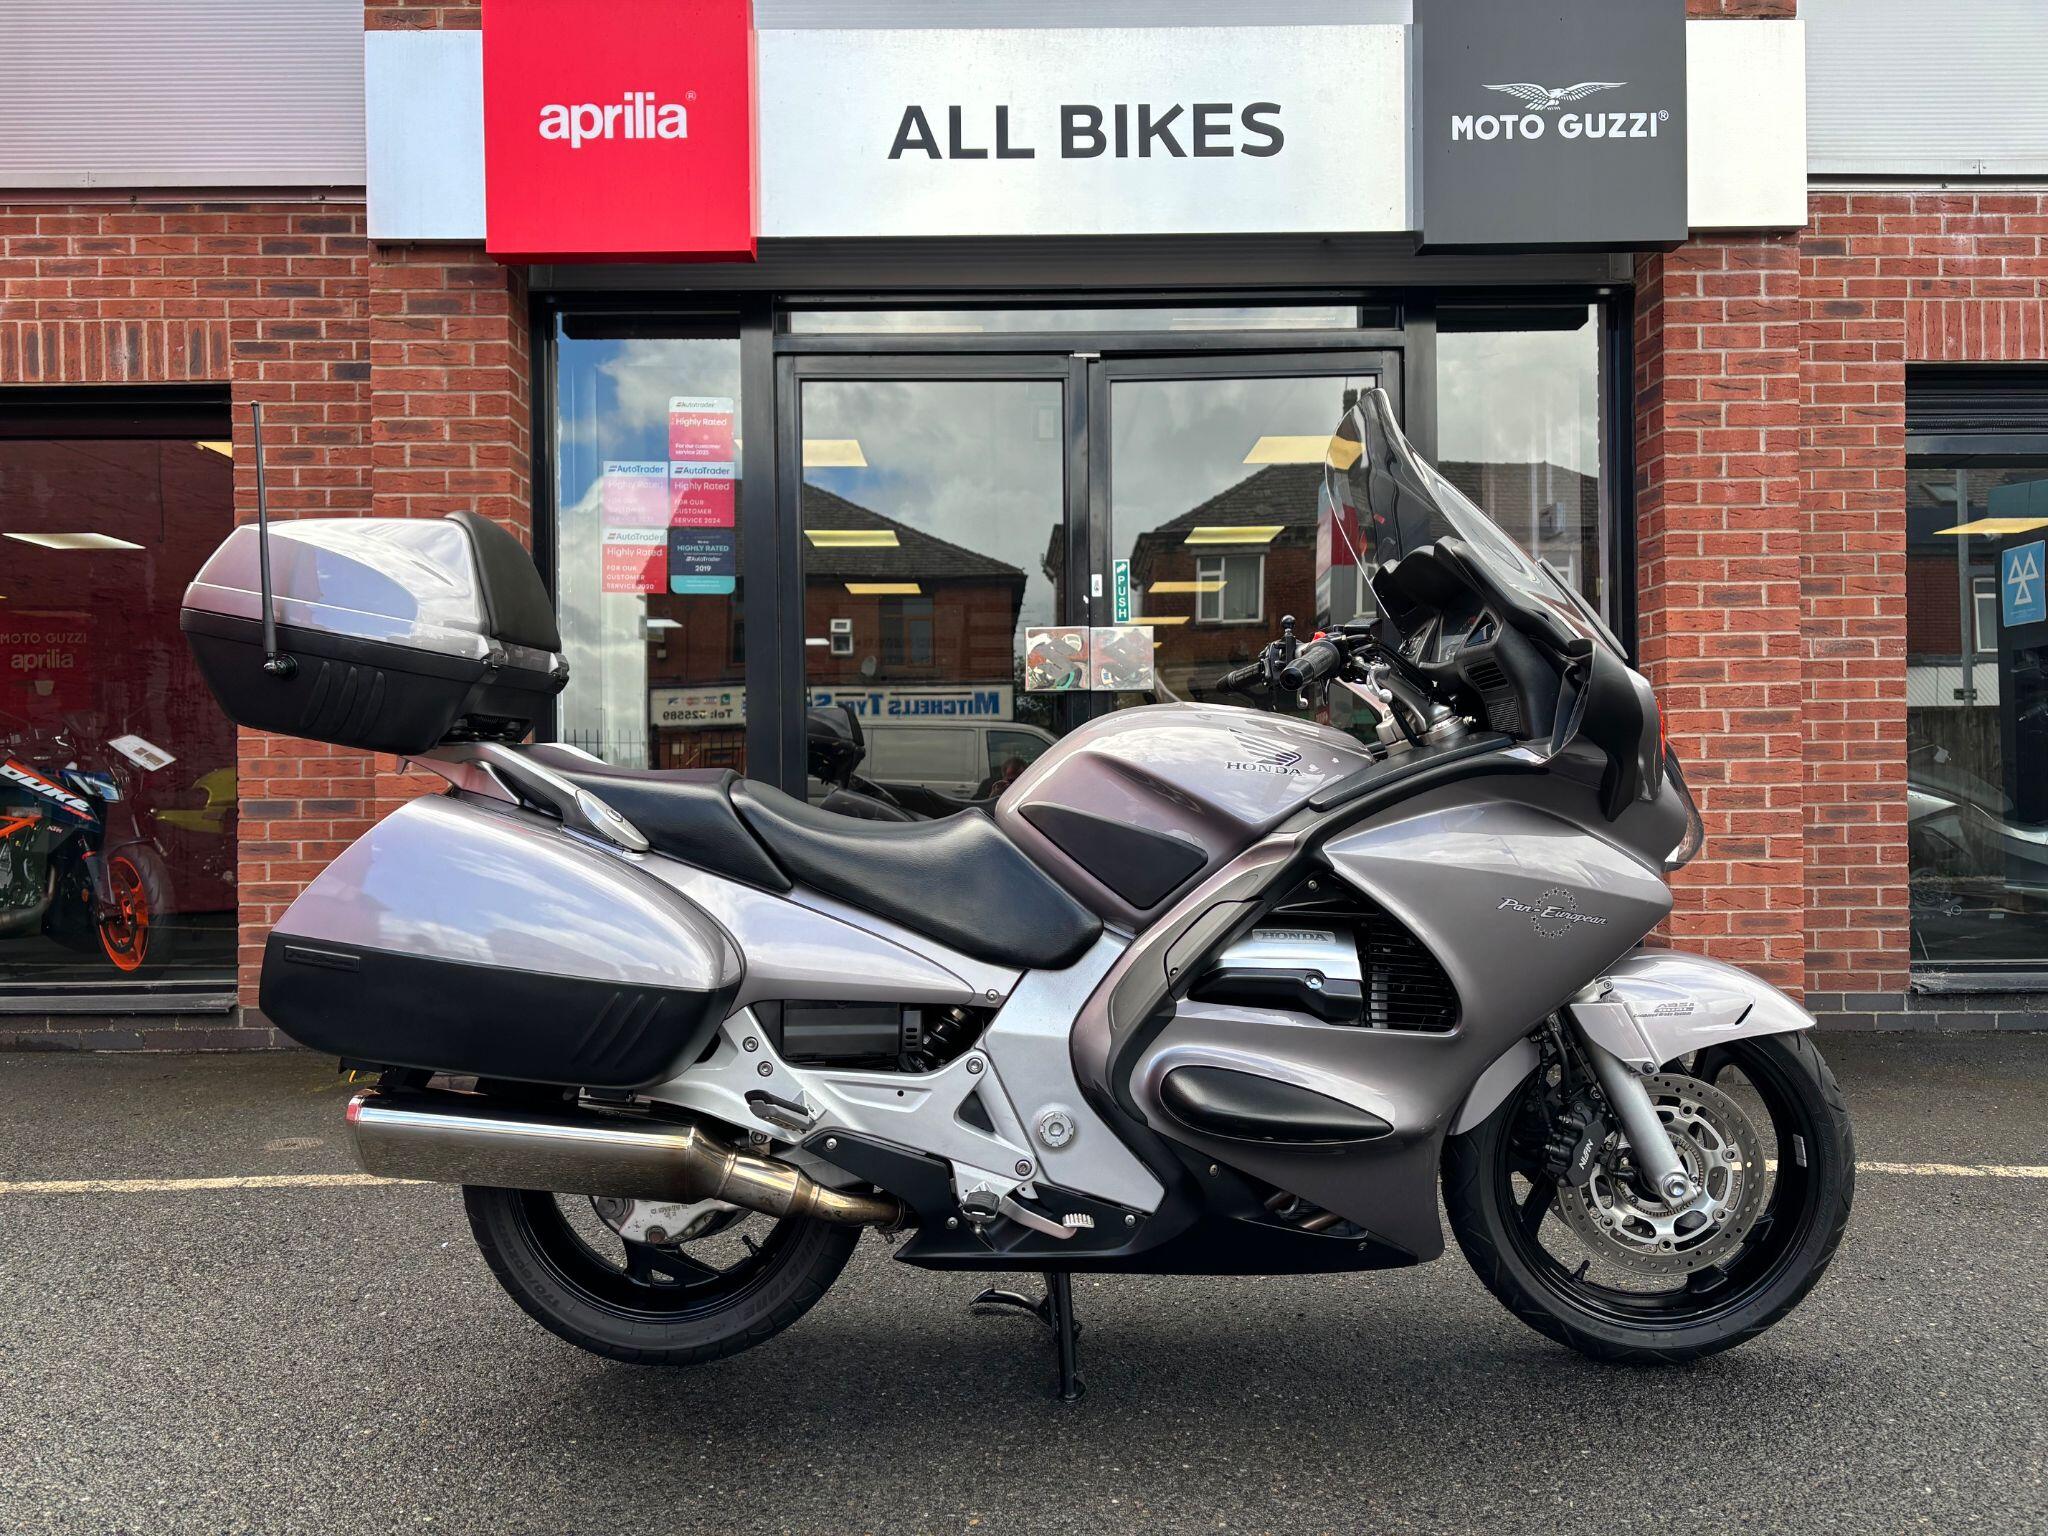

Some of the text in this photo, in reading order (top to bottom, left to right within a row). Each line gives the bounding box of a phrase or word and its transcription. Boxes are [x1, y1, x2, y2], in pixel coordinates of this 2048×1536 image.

[538, 91, 688, 149] aprilia
[1451, 112, 1658, 140] MOTO GUZZI
[887, 102, 1285, 159] ALL BIKES
[675, 417, 727, 427] Highly Rated
[617, 465, 664, 473] AutoTrader
[683, 466, 730, 475] AutoTrader
[674, 481, 730, 492] Highly Rated
[616, 532, 664, 541] AutoTrader
[607, 546, 663, 557] Highly Rated
[677, 544, 704, 552] HIGHLY
[695, 564, 712, 572] 2019
[1117, 575, 1128, 618] PUSH
[0, 632, 87, 644] MOTO GUZZI
[10, 649, 74, 673] aprilia
[1225, 761, 1303, 777] HONDA
[0, 763, 90, 812] DUKE
[1496, 897, 1608, 925] Pan-European
[1262, 931, 1329, 943] HONDA
